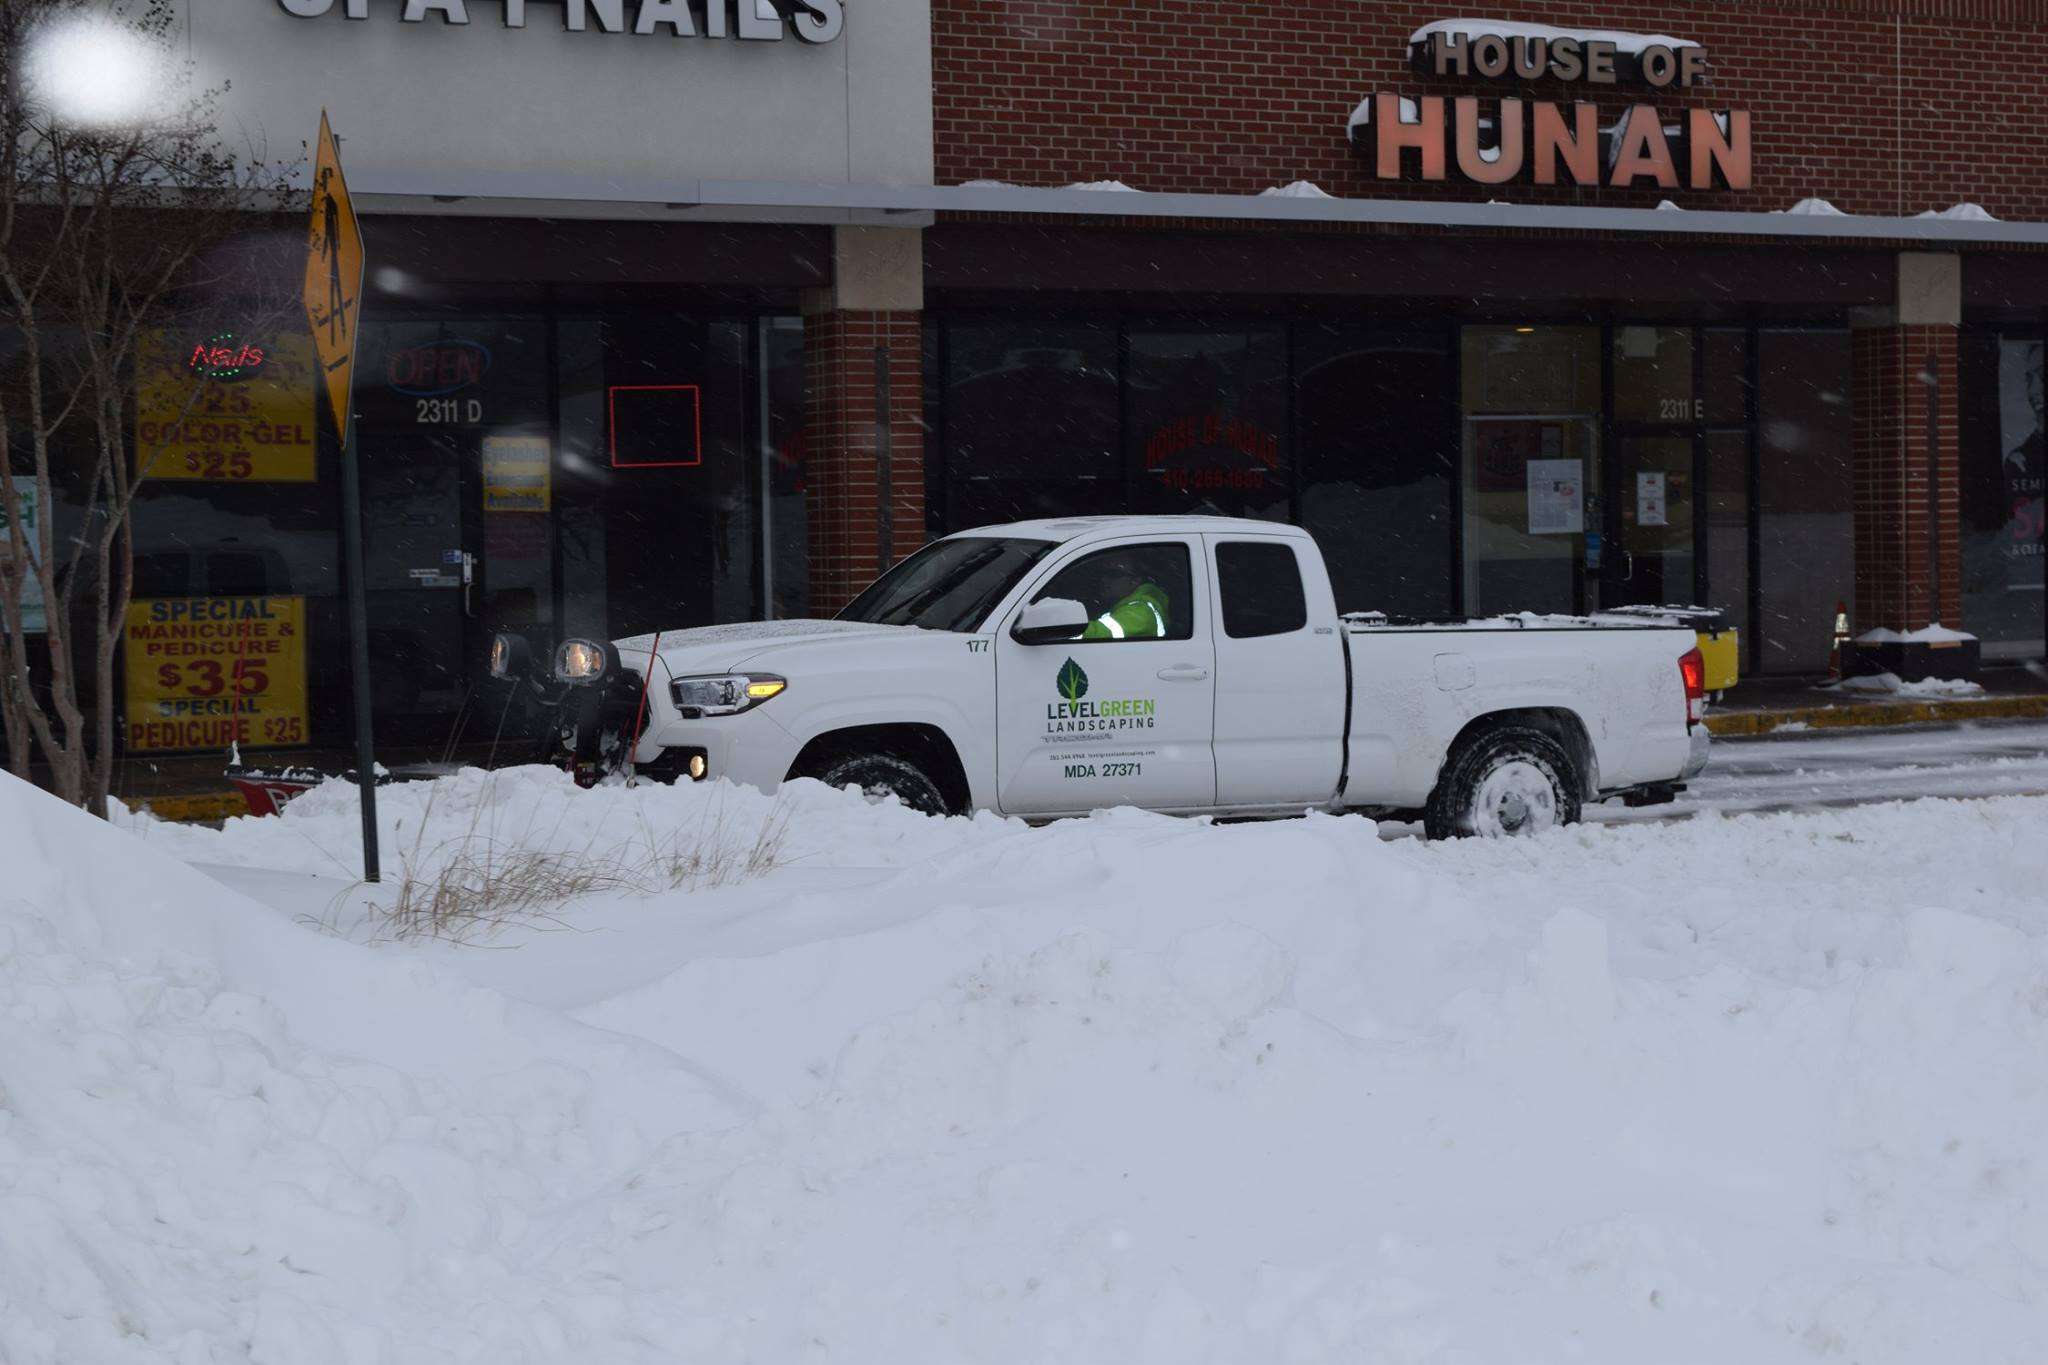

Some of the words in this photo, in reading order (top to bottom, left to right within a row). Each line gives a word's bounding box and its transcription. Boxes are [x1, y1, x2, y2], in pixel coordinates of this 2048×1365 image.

[1434, 31, 1617, 84] HOUSE
[1642, 44, 1708, 87] OF
[1376, 91, 1752, 190] HUNAN
[388, 347, 481, 386] OPEN
[189, 385, 252, 414] 25
[416, 398, 458, 423] 2311
[467, 399, 482, 422] D
[1660, 398, 1689, 419] 2311
[1695, 399, 1704, 419] E
[140, 421, 241, 446] COLOR
[254, 421, 311, 445] GEL
[185, 450, 253, 478] $25
[152, 600, 275, 622] SPECIAL
[130, 622, 268, 640] MANICURE
[278, 622, 295, 637] &
[147, 640, 281, 656] PEDICURE
[966, 640, 989, 652] 177
[158, 658, 269, 696] $35
[159, 699, 261, 717] SPECIAL
[131, 718, 250, 748] PEDICURE
[264, 717, 301, 742] $25
[1047, 717, 1155, 733] LANDSCAPING
[1064, 765, 1097, 778] MDA
[1102, 763, 1142, 776] 27371
